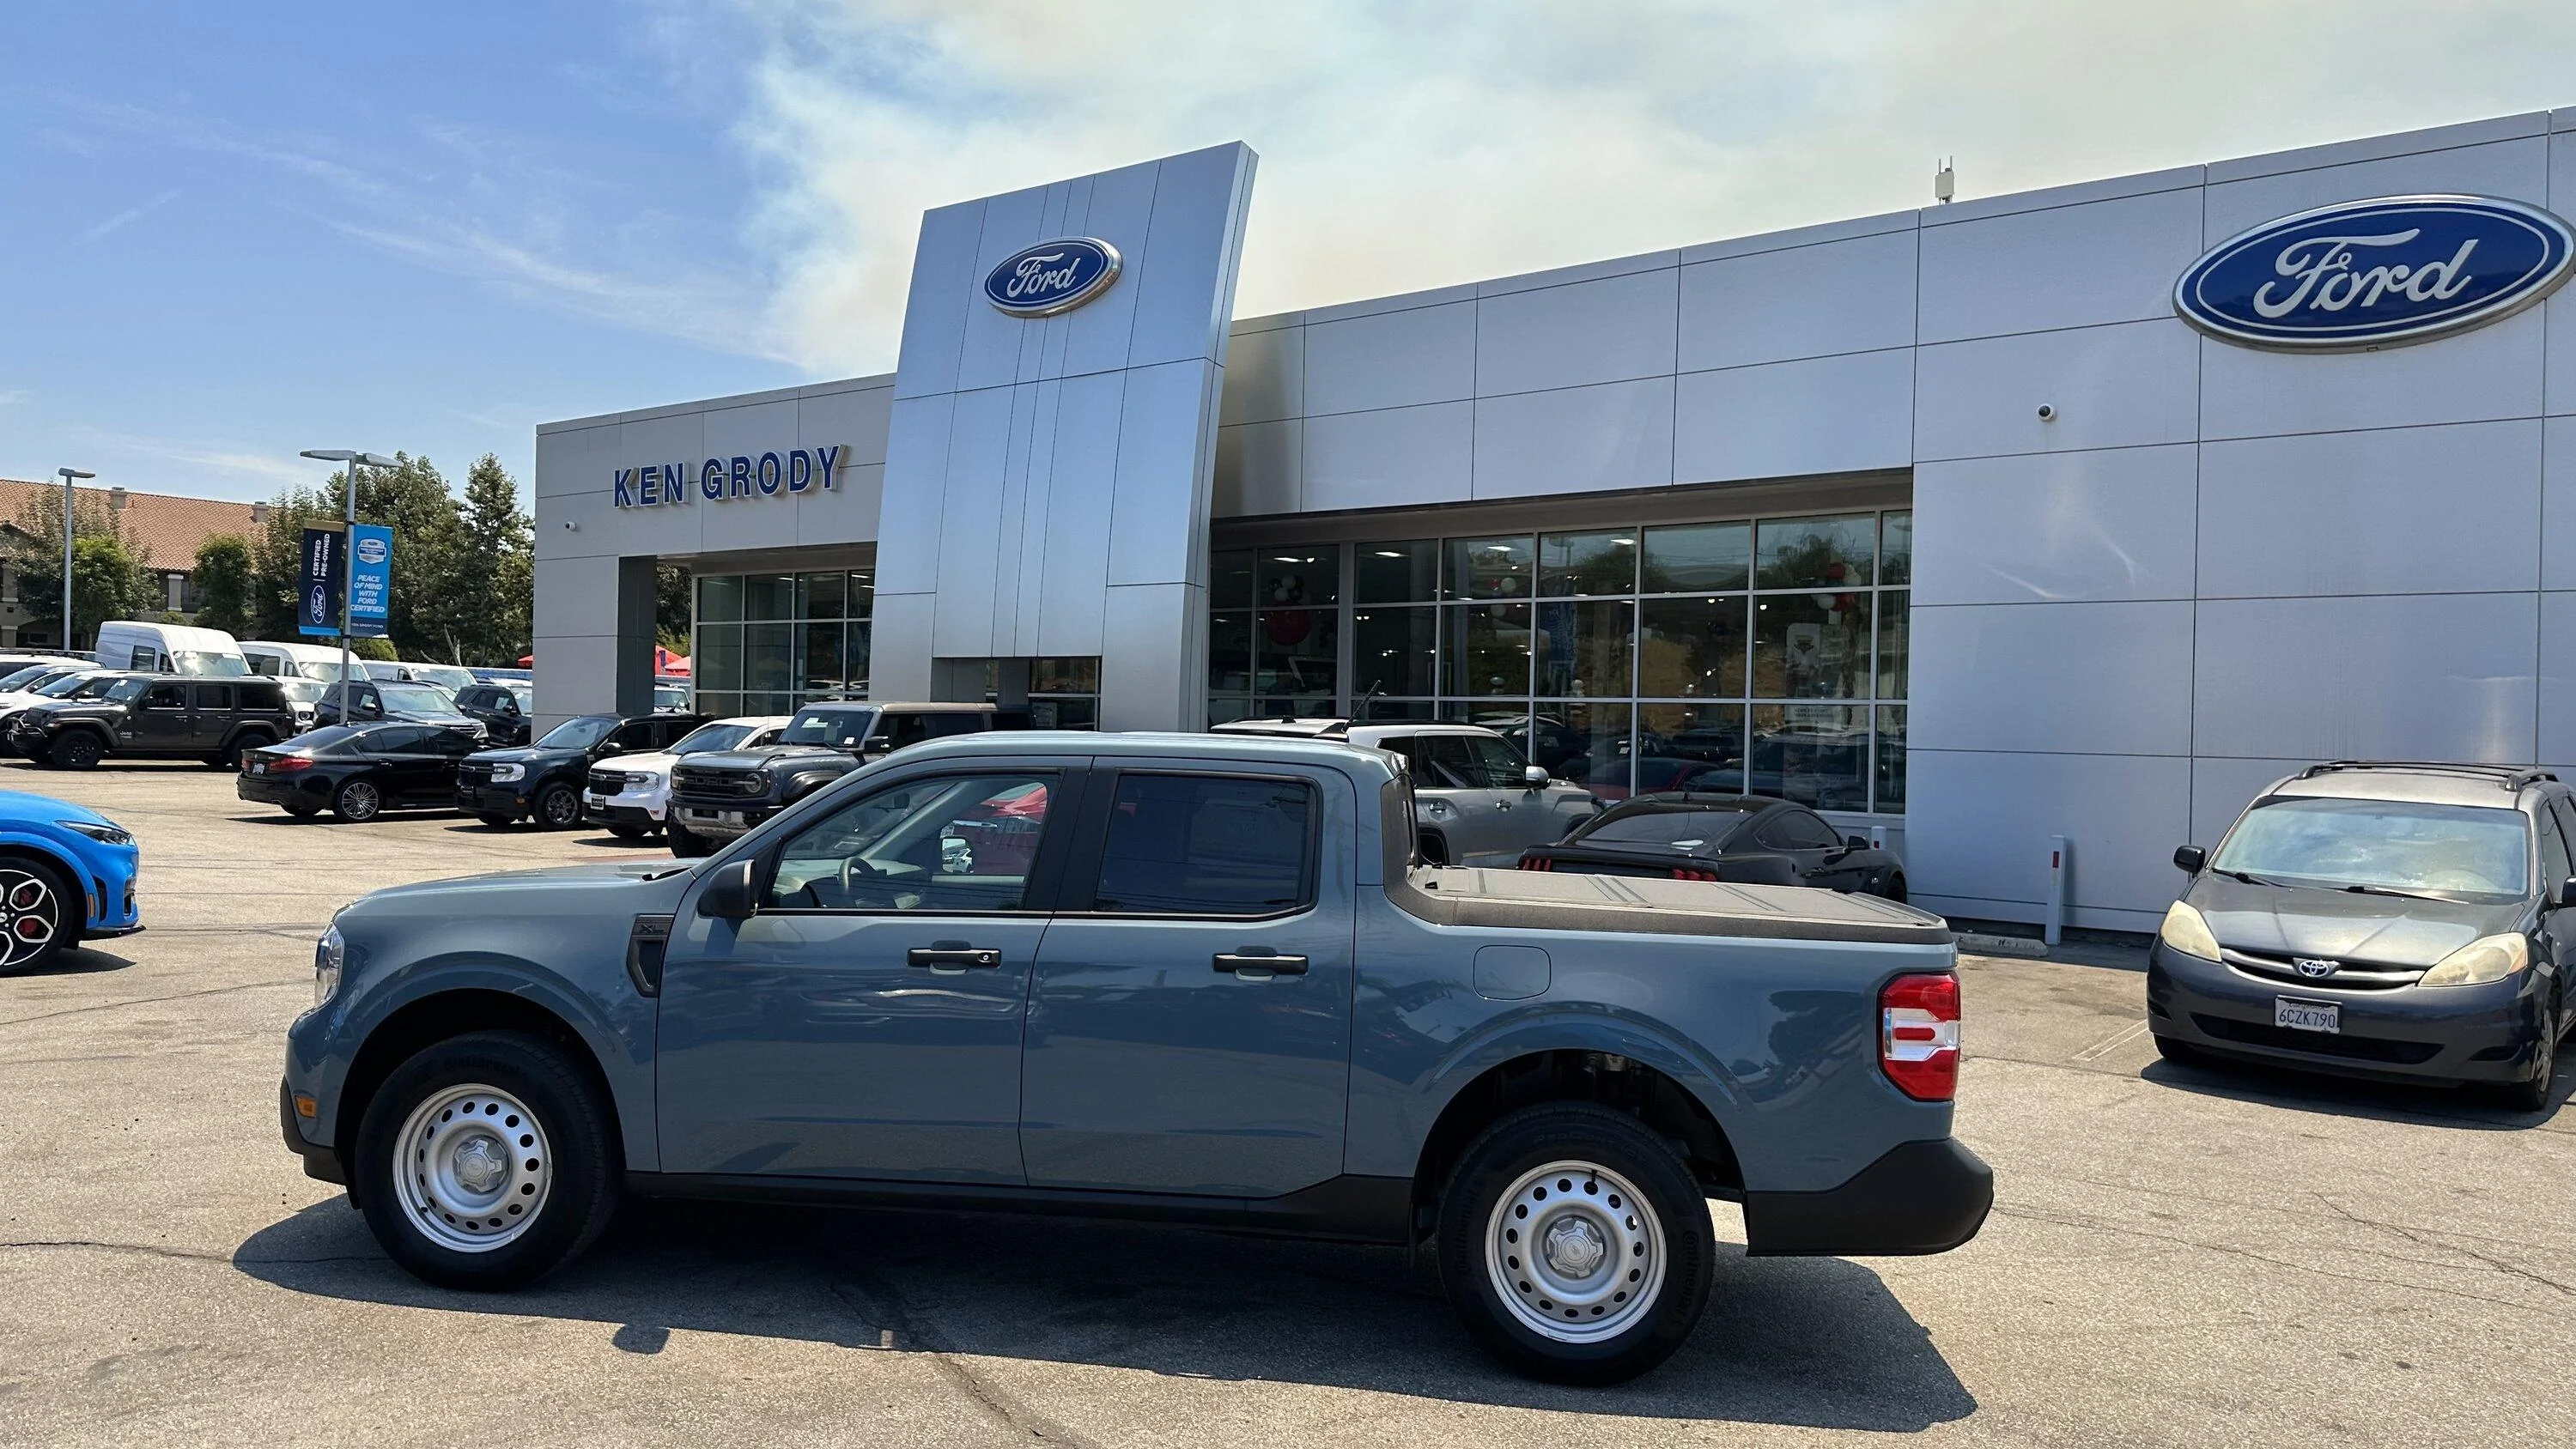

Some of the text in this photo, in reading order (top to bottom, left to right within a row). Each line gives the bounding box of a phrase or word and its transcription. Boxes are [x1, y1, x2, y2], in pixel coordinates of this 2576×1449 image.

[1006, 252, 1081, 298] Ford
[2252, 227, 2480, 319] Ford
[613, 443, 844, 508] KEN GRODY
[313, 539, 322, 576] CERTIFIED
[320, 533, 331, 577] PRE-OWNED
[357, 574, 381, 583] PEACE
[313, 592, 324, 617] Ford
[350, 604, 386, 613] CERTIFIED
[357, 597, 378, 605] FORD
[638, 923, 665, 934] XL
[2279, 1009, 2336, 1028] 6CZK790
